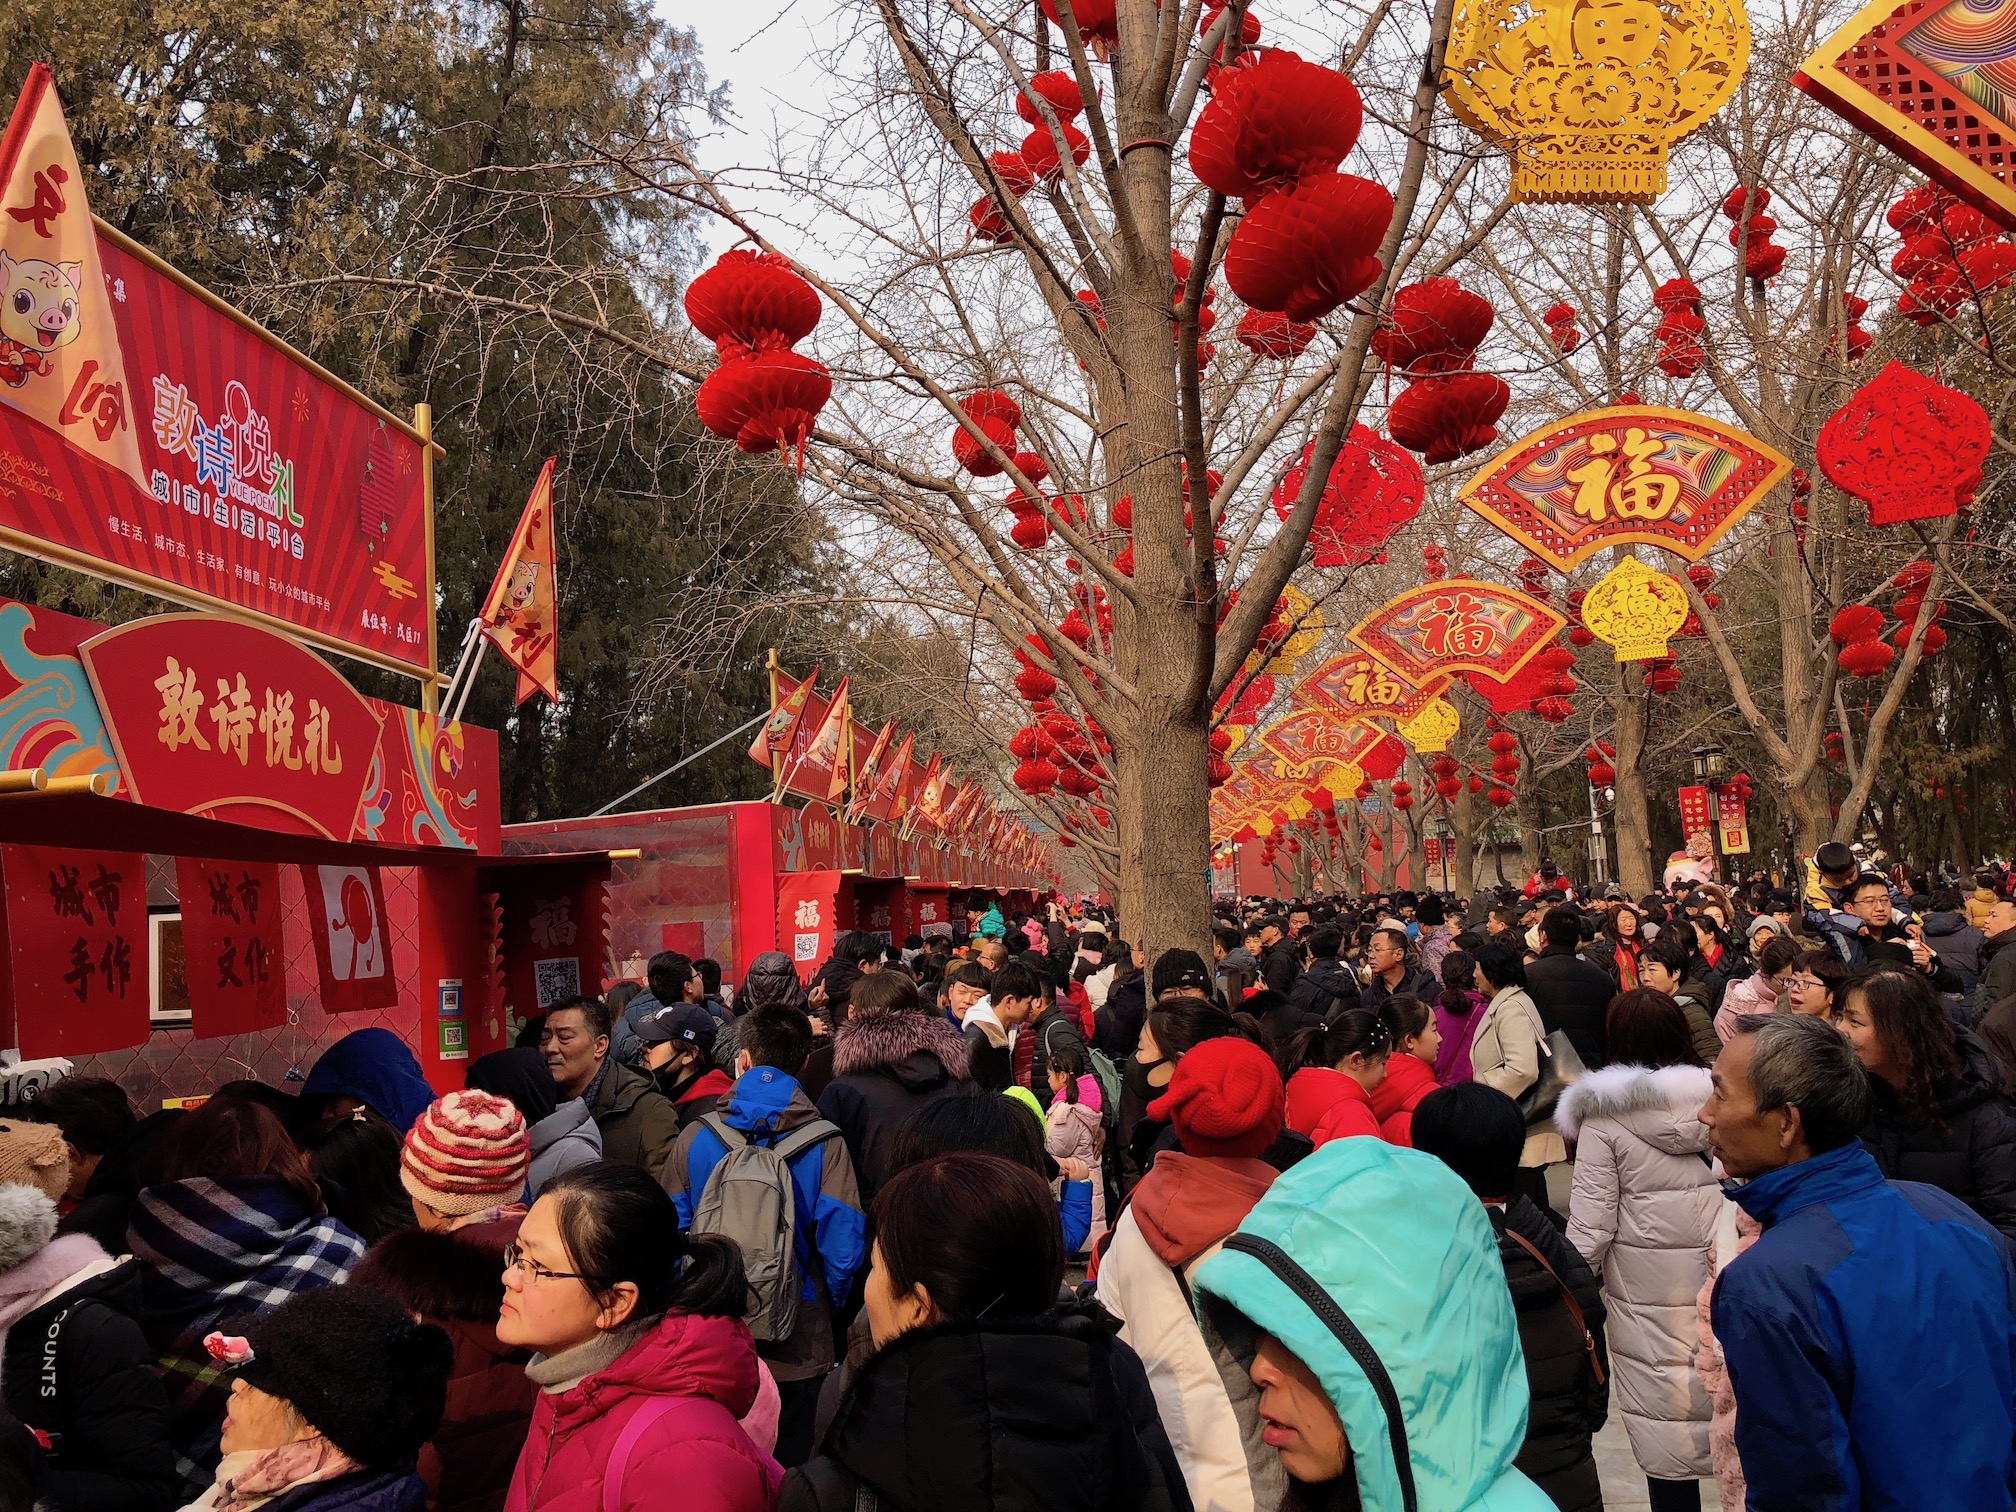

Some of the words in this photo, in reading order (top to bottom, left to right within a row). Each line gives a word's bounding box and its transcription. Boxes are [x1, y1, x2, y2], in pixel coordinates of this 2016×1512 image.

[152, 374, 304, 528] 敦诗悦礼
[1567, 427, 1682, 522] 福
[229, 478, 250, 500] YUE
[250, 490, 276, 513] POEM
[1418, 592, 1497, 658] 福
[1343, 658, 1402, 706] 福
[153, 655, 343, 776] 敦诗悦礼
[1297, 715, 1345, 754] 福
[48, 864, 123, 927] 城市
[207, 866, 261, 925] 城市
[530, 895, 578, 950] 福
[794, 899, 821, 930] 福
[870, 904, 892, 927] 福
[919, 902, 938, 921] 福
[63, 935, 132, 1003] 手作
[216, 938, 270, 989] 文化
